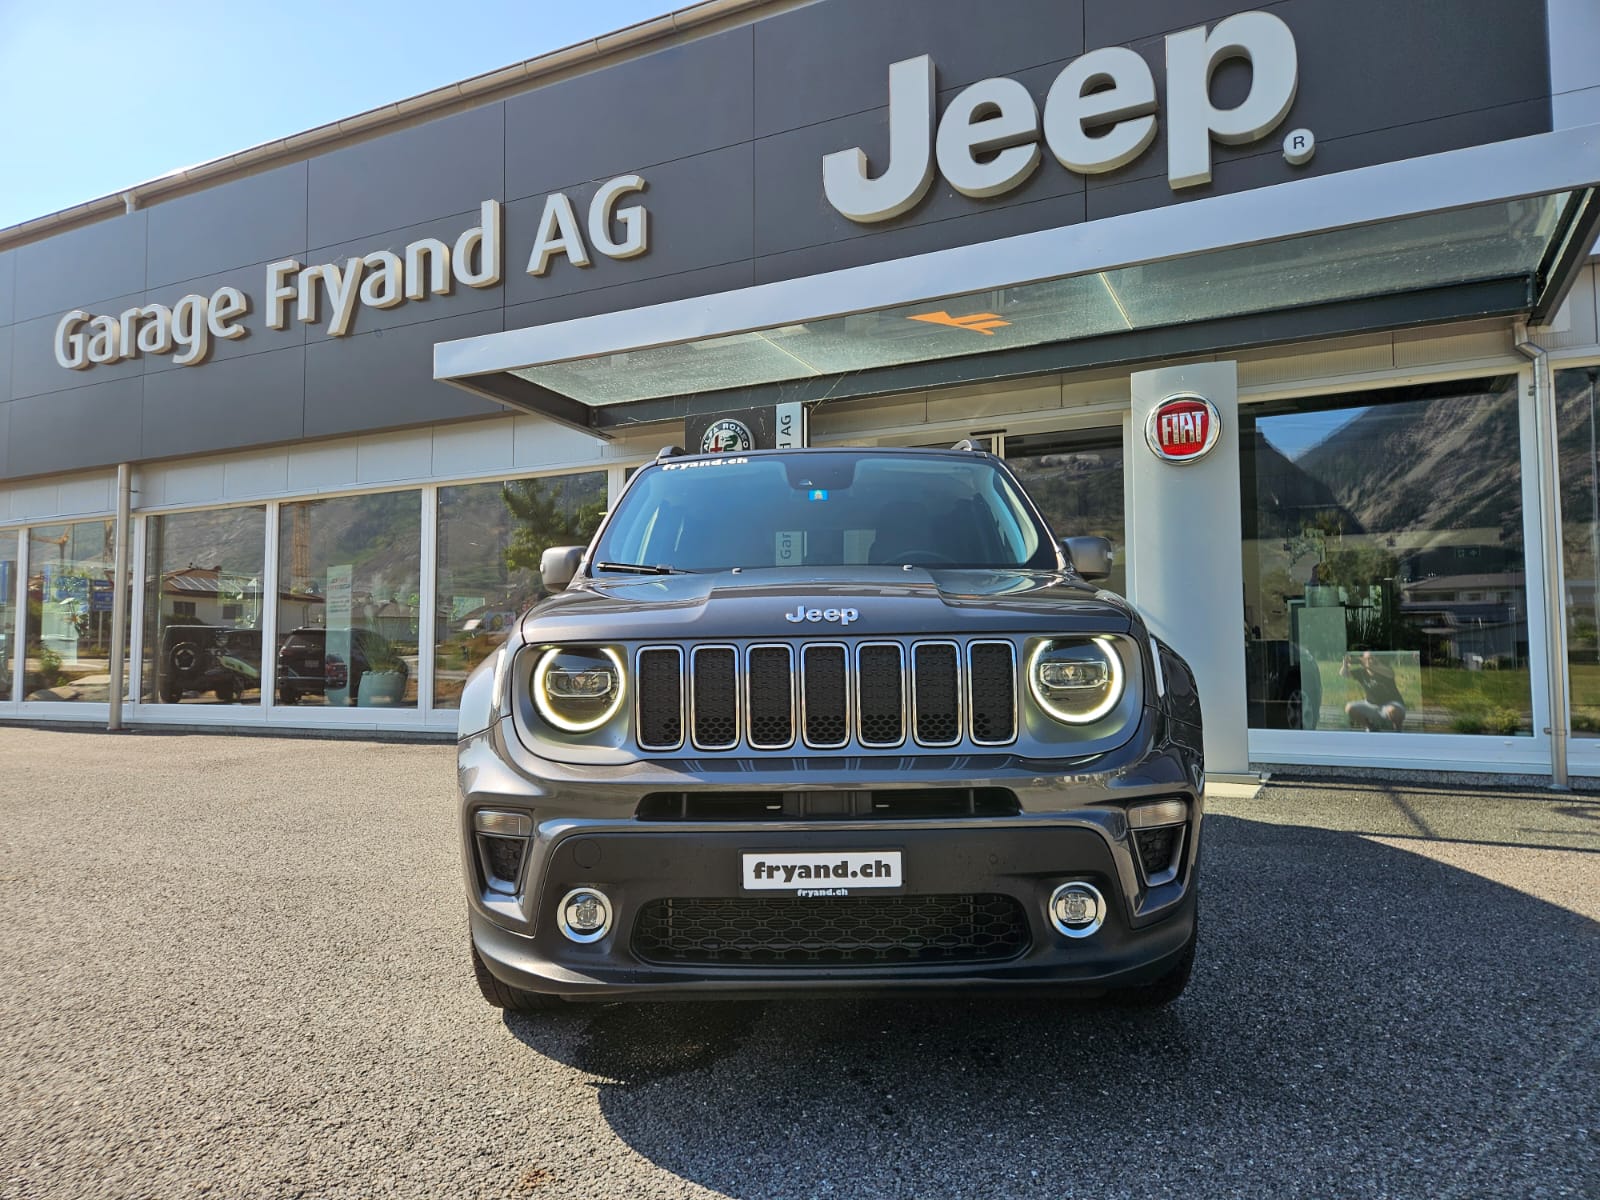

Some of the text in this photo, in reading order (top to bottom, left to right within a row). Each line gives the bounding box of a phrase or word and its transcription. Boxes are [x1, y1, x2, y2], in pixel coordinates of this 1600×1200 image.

[822, 11, 1298, 223] Jeep
[54, 174, 648, 371] Garage Fryand AG
[780, 414, 792, 436] AG
[1161, 411, 1206, 446] FIAT
[662, 457, 749, 471] fryand.ch
[785, 605, 859, 626] Jeep
[752, 859, 892, 883] fryand.ch
[797, 888, 849, 898] fryand.ch
